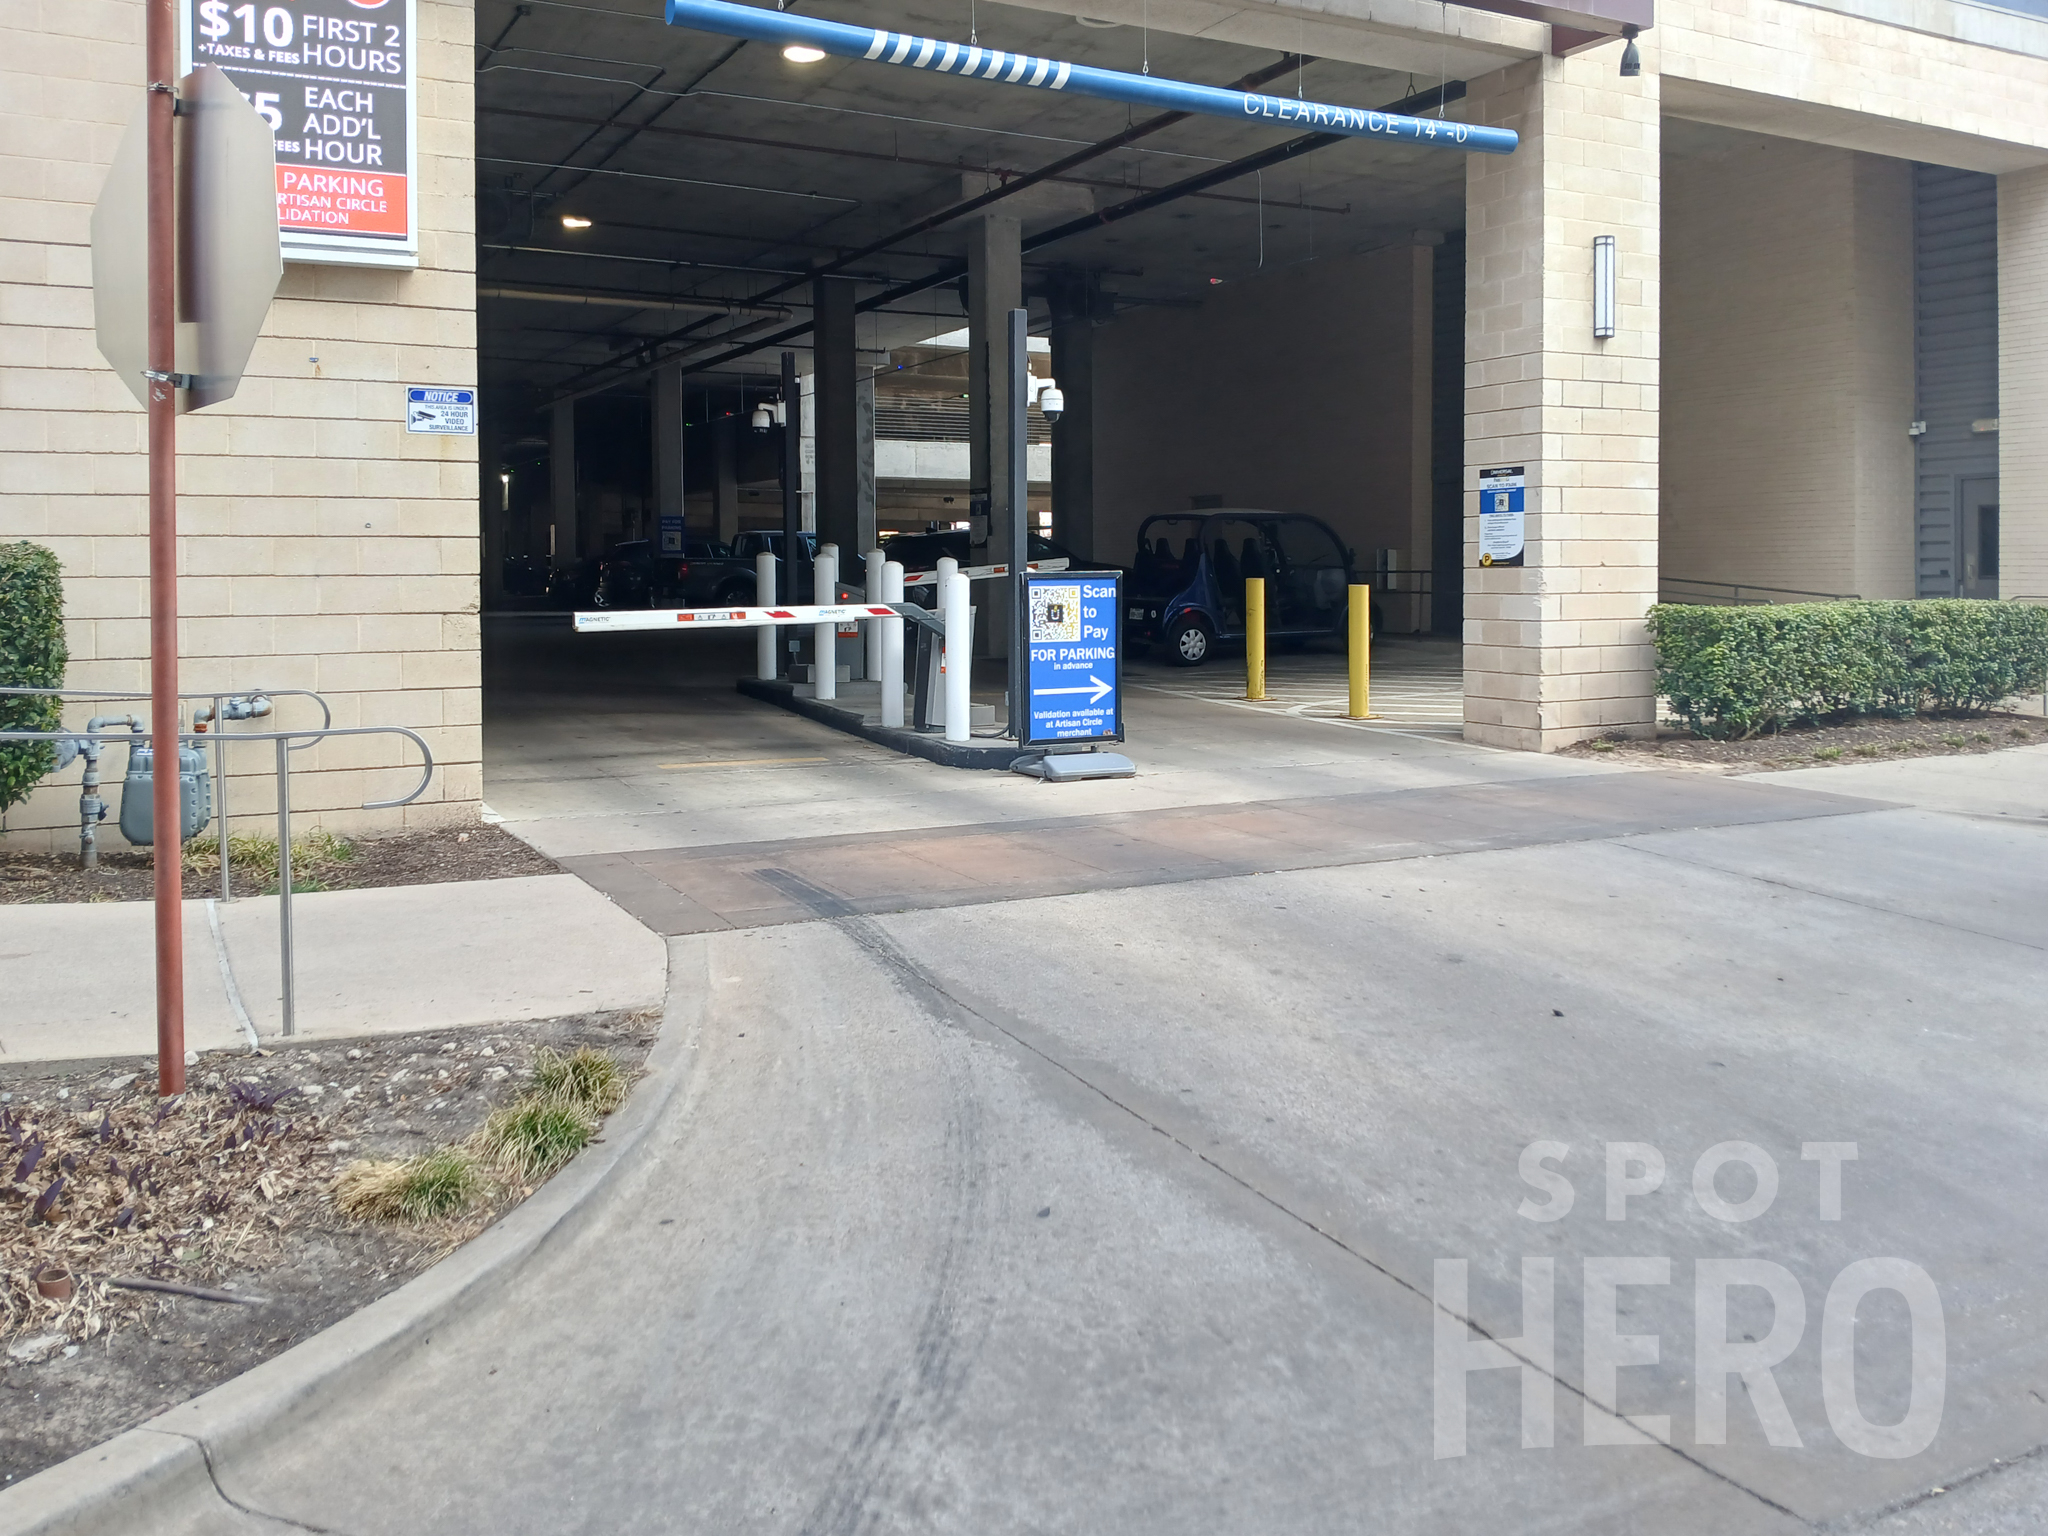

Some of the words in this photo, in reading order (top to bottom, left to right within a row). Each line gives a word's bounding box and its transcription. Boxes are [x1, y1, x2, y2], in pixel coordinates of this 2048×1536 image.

[200, 0, 294, 47] $10
[303, 14, 377, 44] FIRST
[384, 25, 400, 47] 2
[198, 42, 250, 59] +TAXES
[253, 48, 265, 61] &
[268, 51, 300, 64] FEES
[303, 42, 402, 75] HOURS
[304, 86, 373, 114] EACH
[1243, 93, 1399, 135] CLEARANCE
[302, 112, 382, 140] ADD'L
[304, 138, 383, 166] HOUR
[283, 171, 384, 197] PARKING
[277, 192, 332, 208] RTISAN
[335, 196, 388, 213] CIRCLE
[424, 391, 459, 402] NOTICE
[1082, 585, 1116, 599] Scan
[1083, 605, 1098, 619] to
[1083, 625, 1109, 641] Pay
[1031, 649, 1057, 662] FOR
[1060, 647, 1115, 661] PARKING
[1053, 662, 1061, 670] in
[1062, 661, 1093, 670] advance
[1033, 710, 1071, 719] Validation
[1072, 708, 1105, 718] available
[1055, 719, 1081, 728] Artisan
[1082, 717, 1103, 726] Circle
[1057, 728, 1092, 737] merchant
